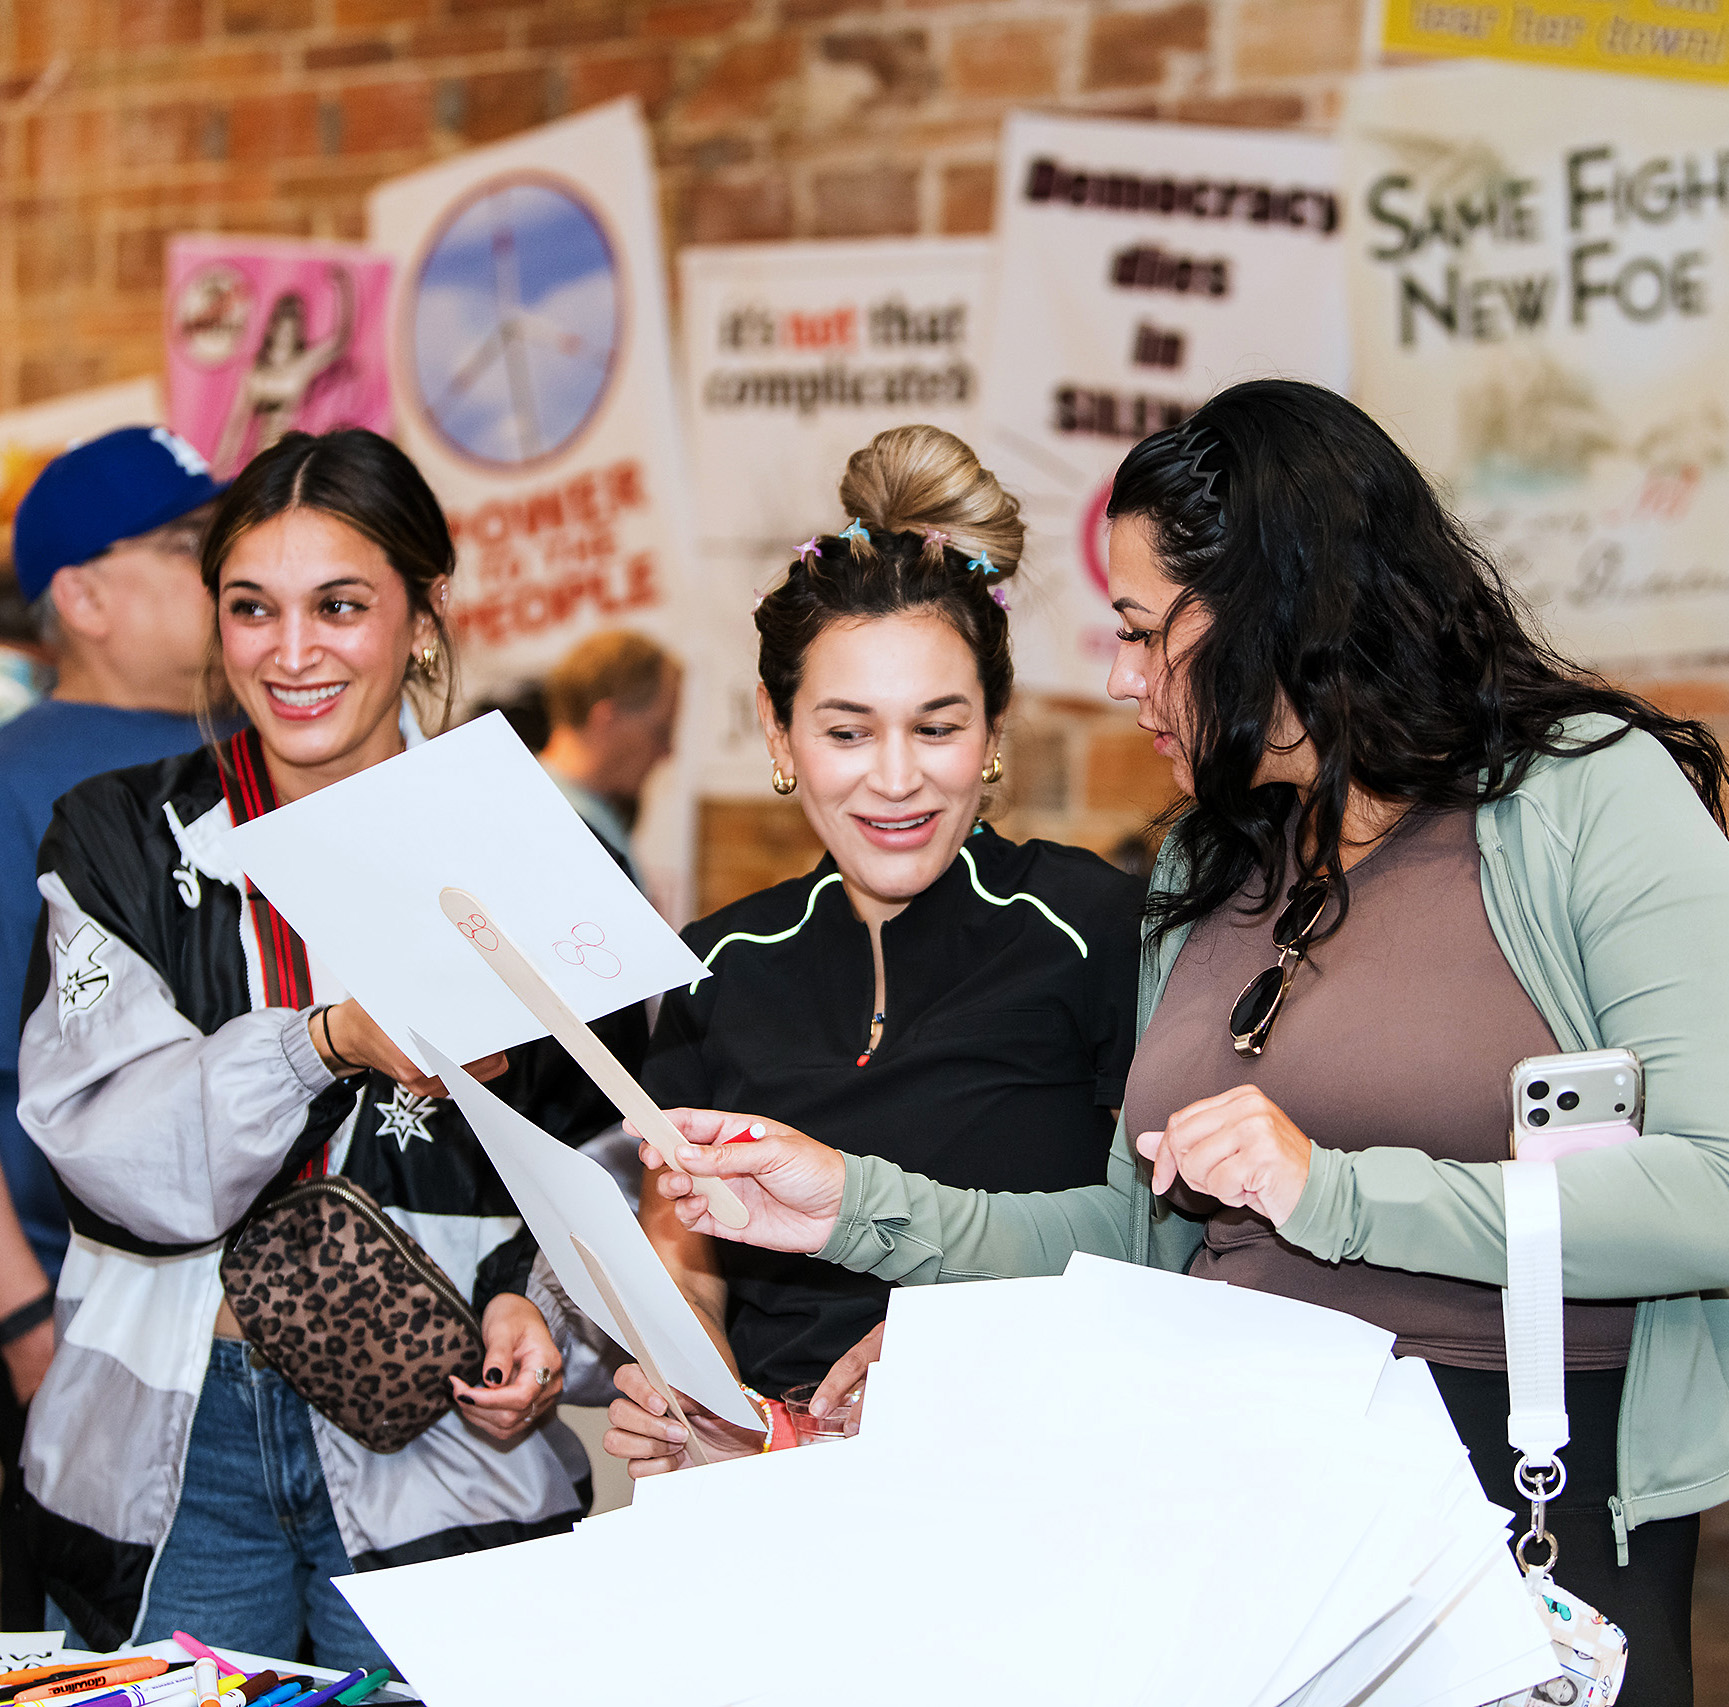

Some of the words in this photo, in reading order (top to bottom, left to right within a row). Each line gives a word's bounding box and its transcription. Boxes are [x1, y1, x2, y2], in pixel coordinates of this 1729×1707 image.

[1025, 155, 1341, 238] Democracy
[1367, 174, 1538, 262] SAME
[1565, 145, 1729, 232] FIGH
[1398, 263, 1551, 349] NEW
[1569, 240, 1706, 330] FOE
[1134, 320, 1183, 367] in
[1054, 383, 1204, 440] SILEN
[452, 549, 661, 650] PEOPLE
